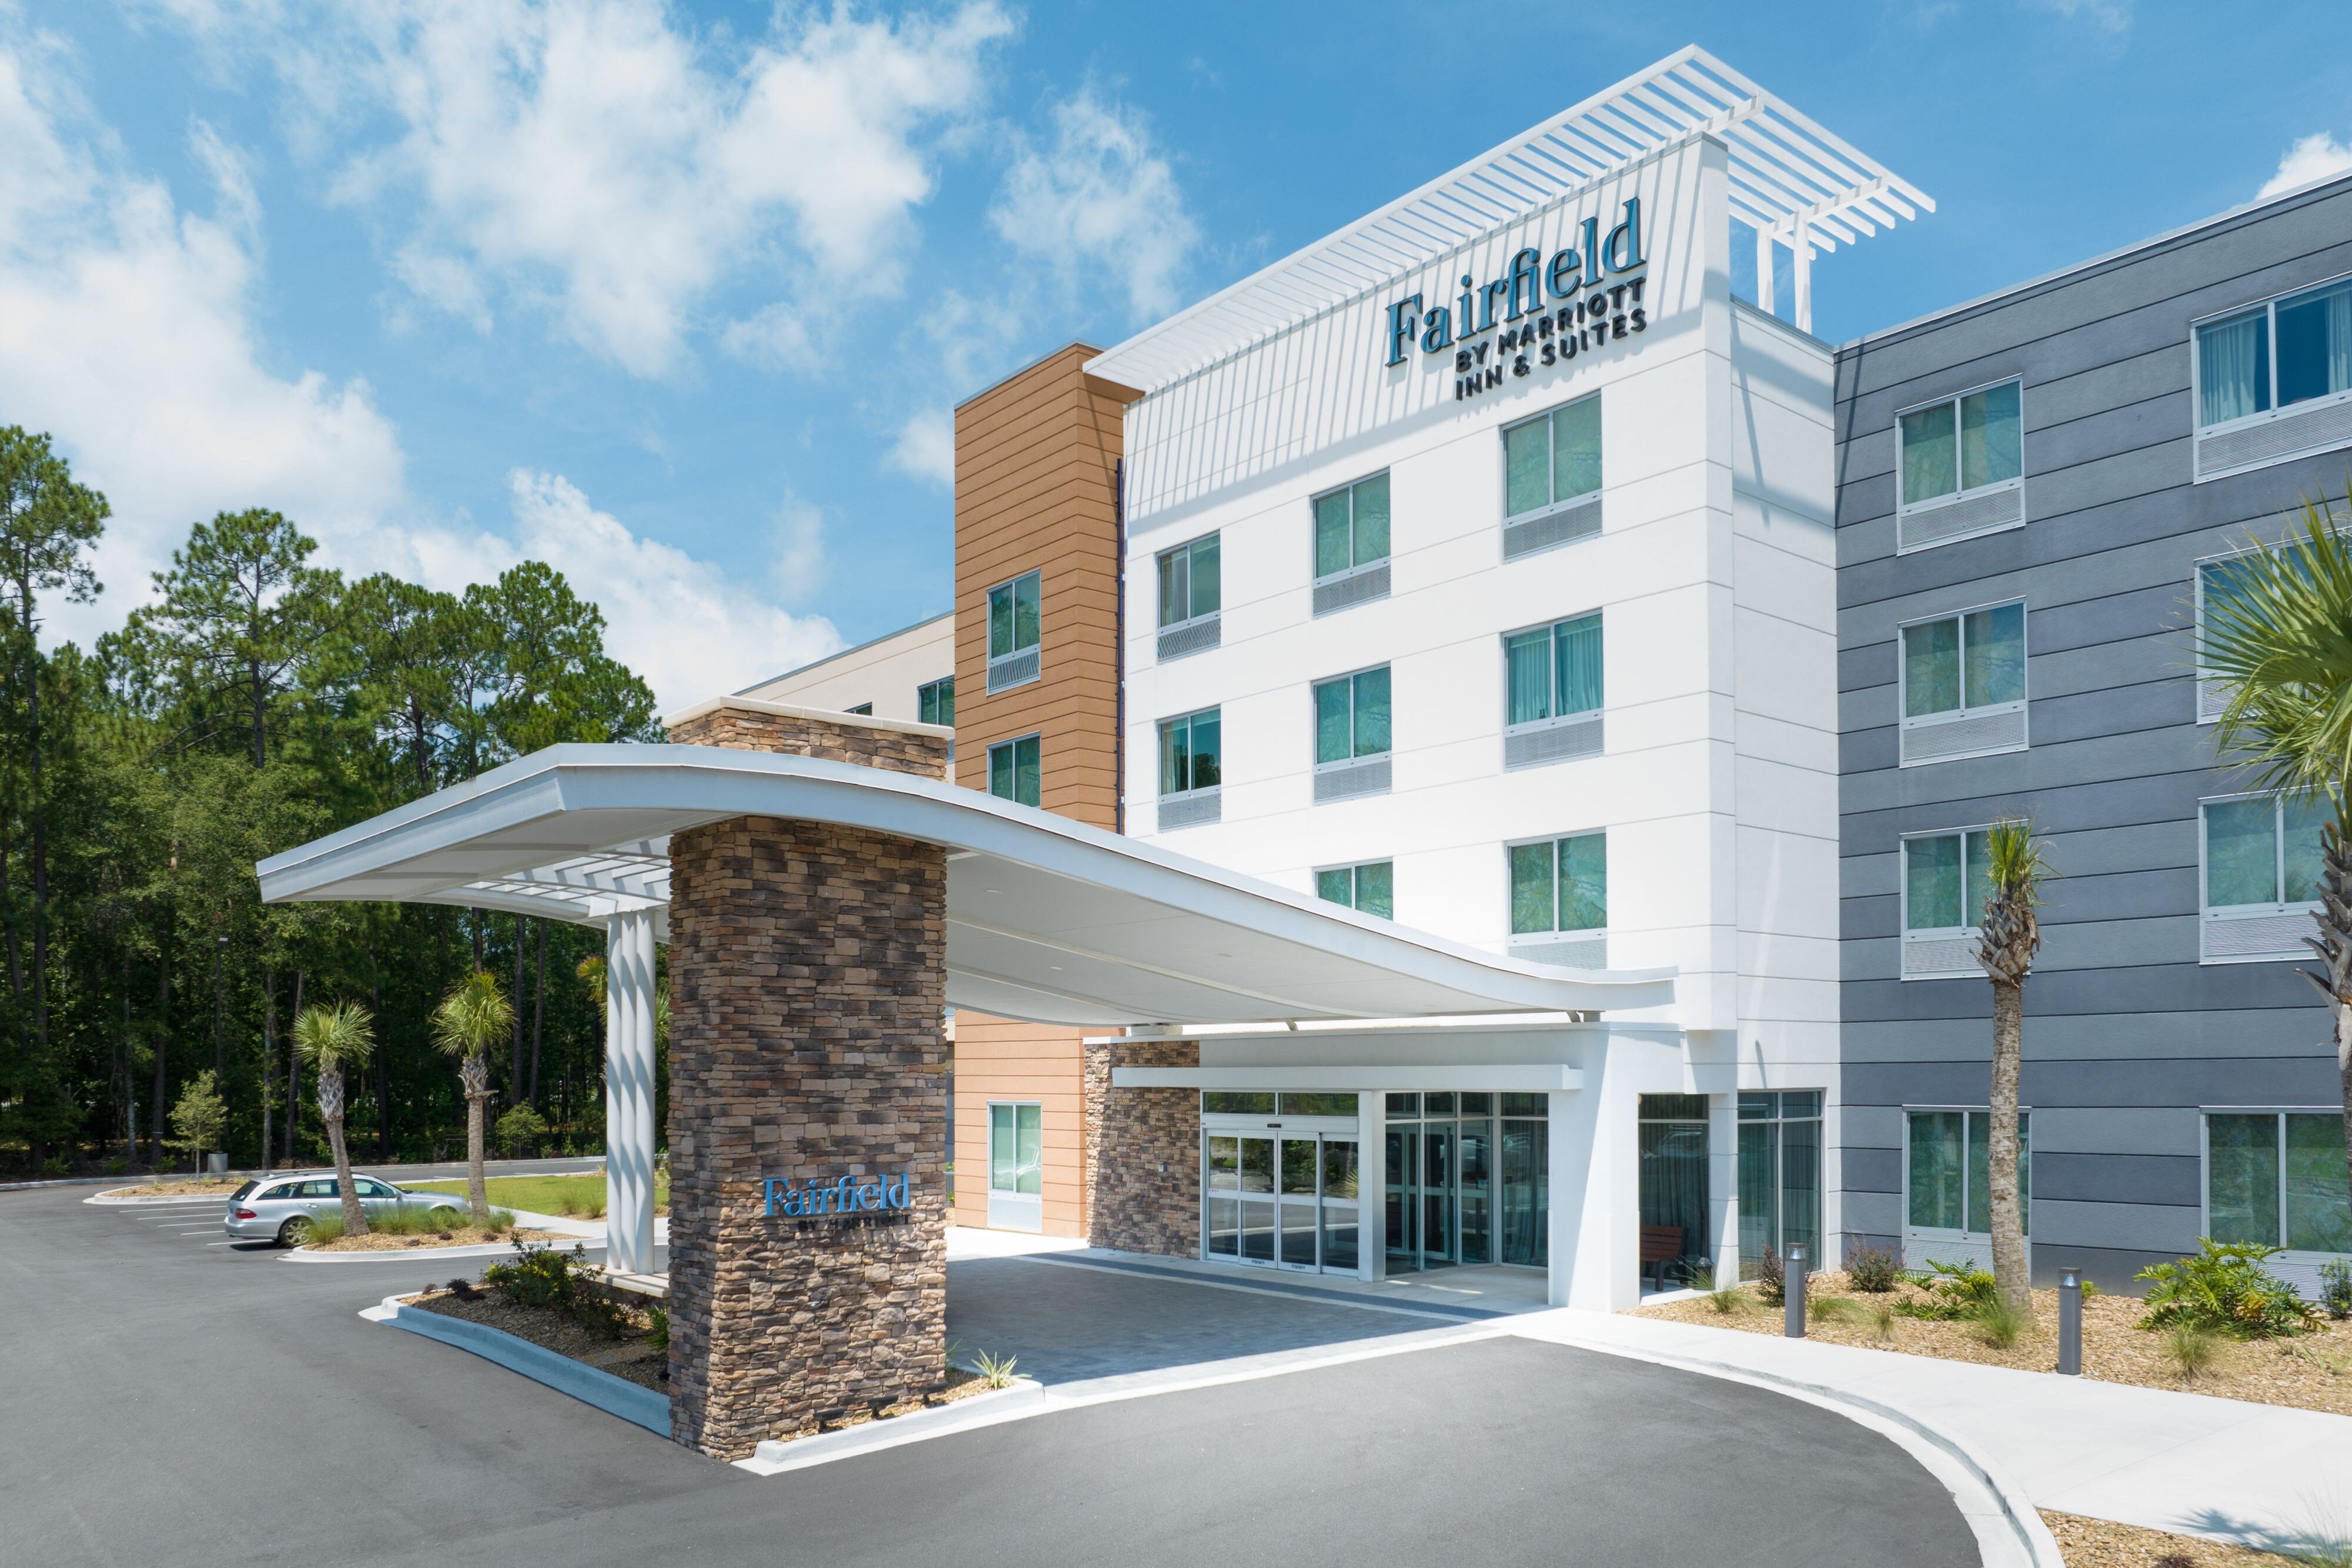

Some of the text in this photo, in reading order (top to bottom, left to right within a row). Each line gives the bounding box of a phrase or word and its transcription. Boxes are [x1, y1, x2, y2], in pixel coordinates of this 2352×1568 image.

[1385, 197, 1646, 367] Fairfield
[1456, 276, 1646, 373] BY MARRIOTT
[1456, 308, 1647, 400] INN & SUITES
[762, 1172, 911, 1216] Fairfield
[798, 1219, 818, 1231] BY
